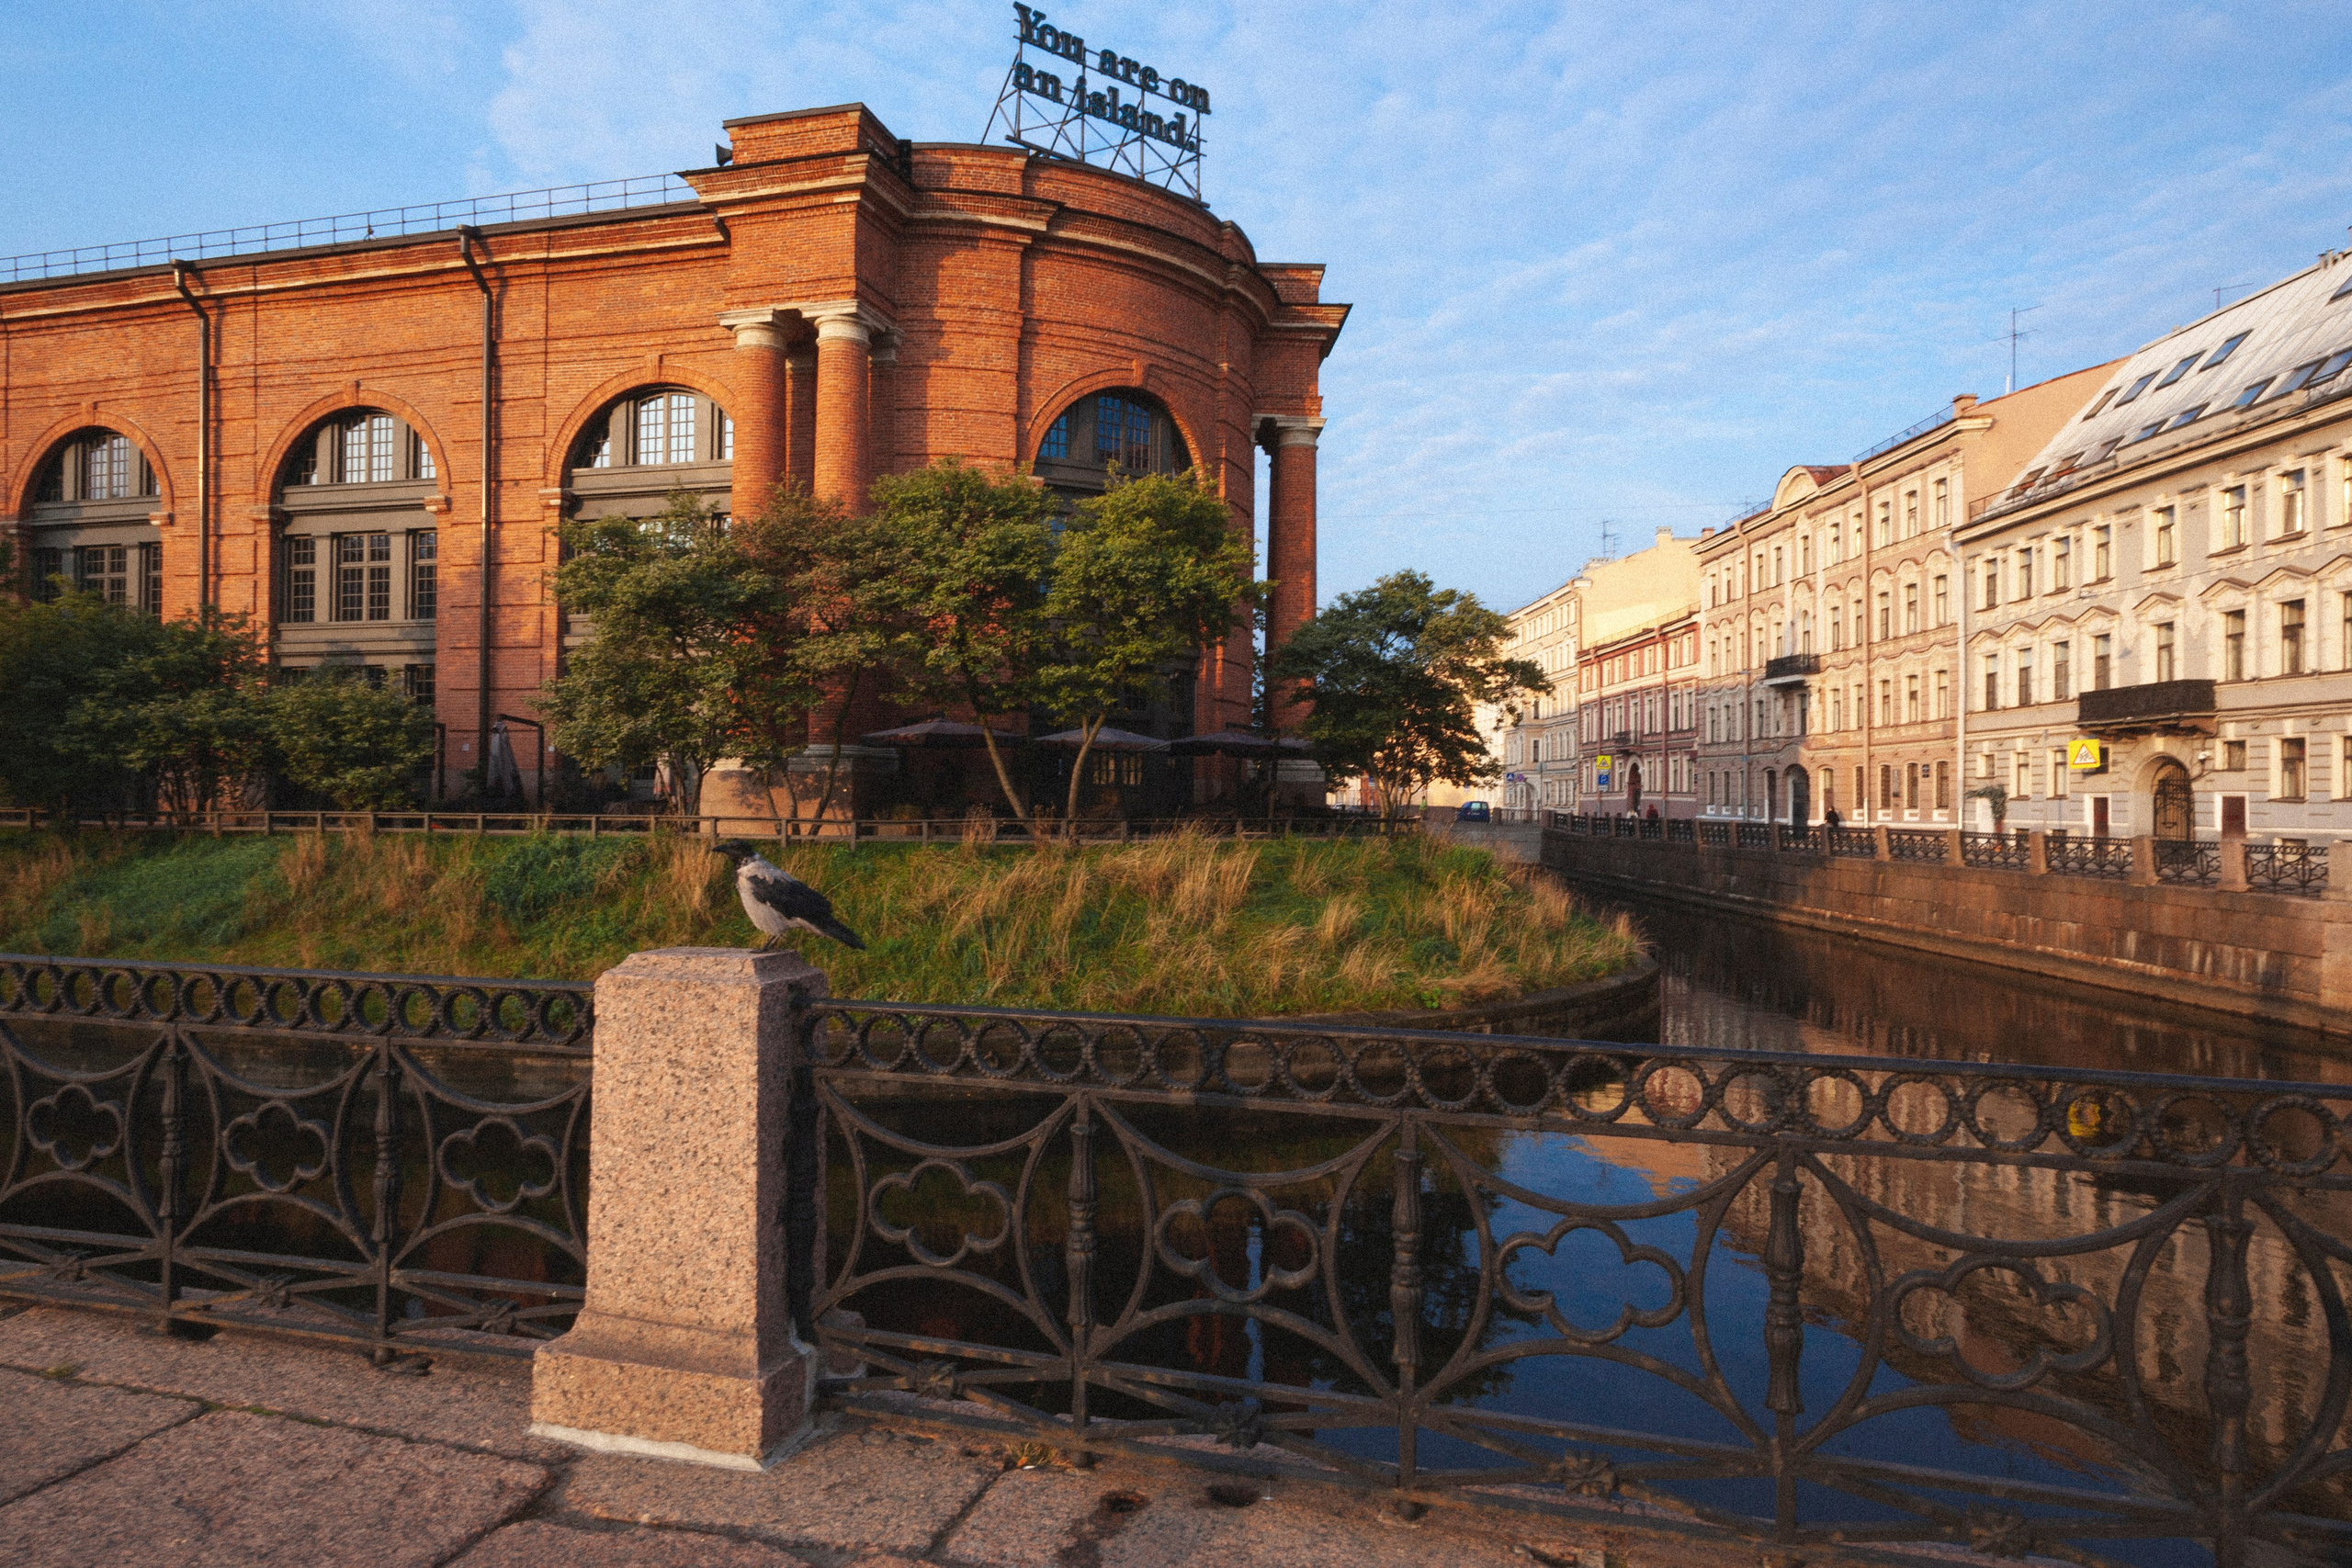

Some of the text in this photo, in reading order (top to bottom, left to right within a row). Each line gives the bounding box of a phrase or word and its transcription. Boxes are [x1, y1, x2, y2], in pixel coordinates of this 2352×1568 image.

[1012, 2, 1211, 115] You are on
[1012, 62, 1196, 152] an island.
